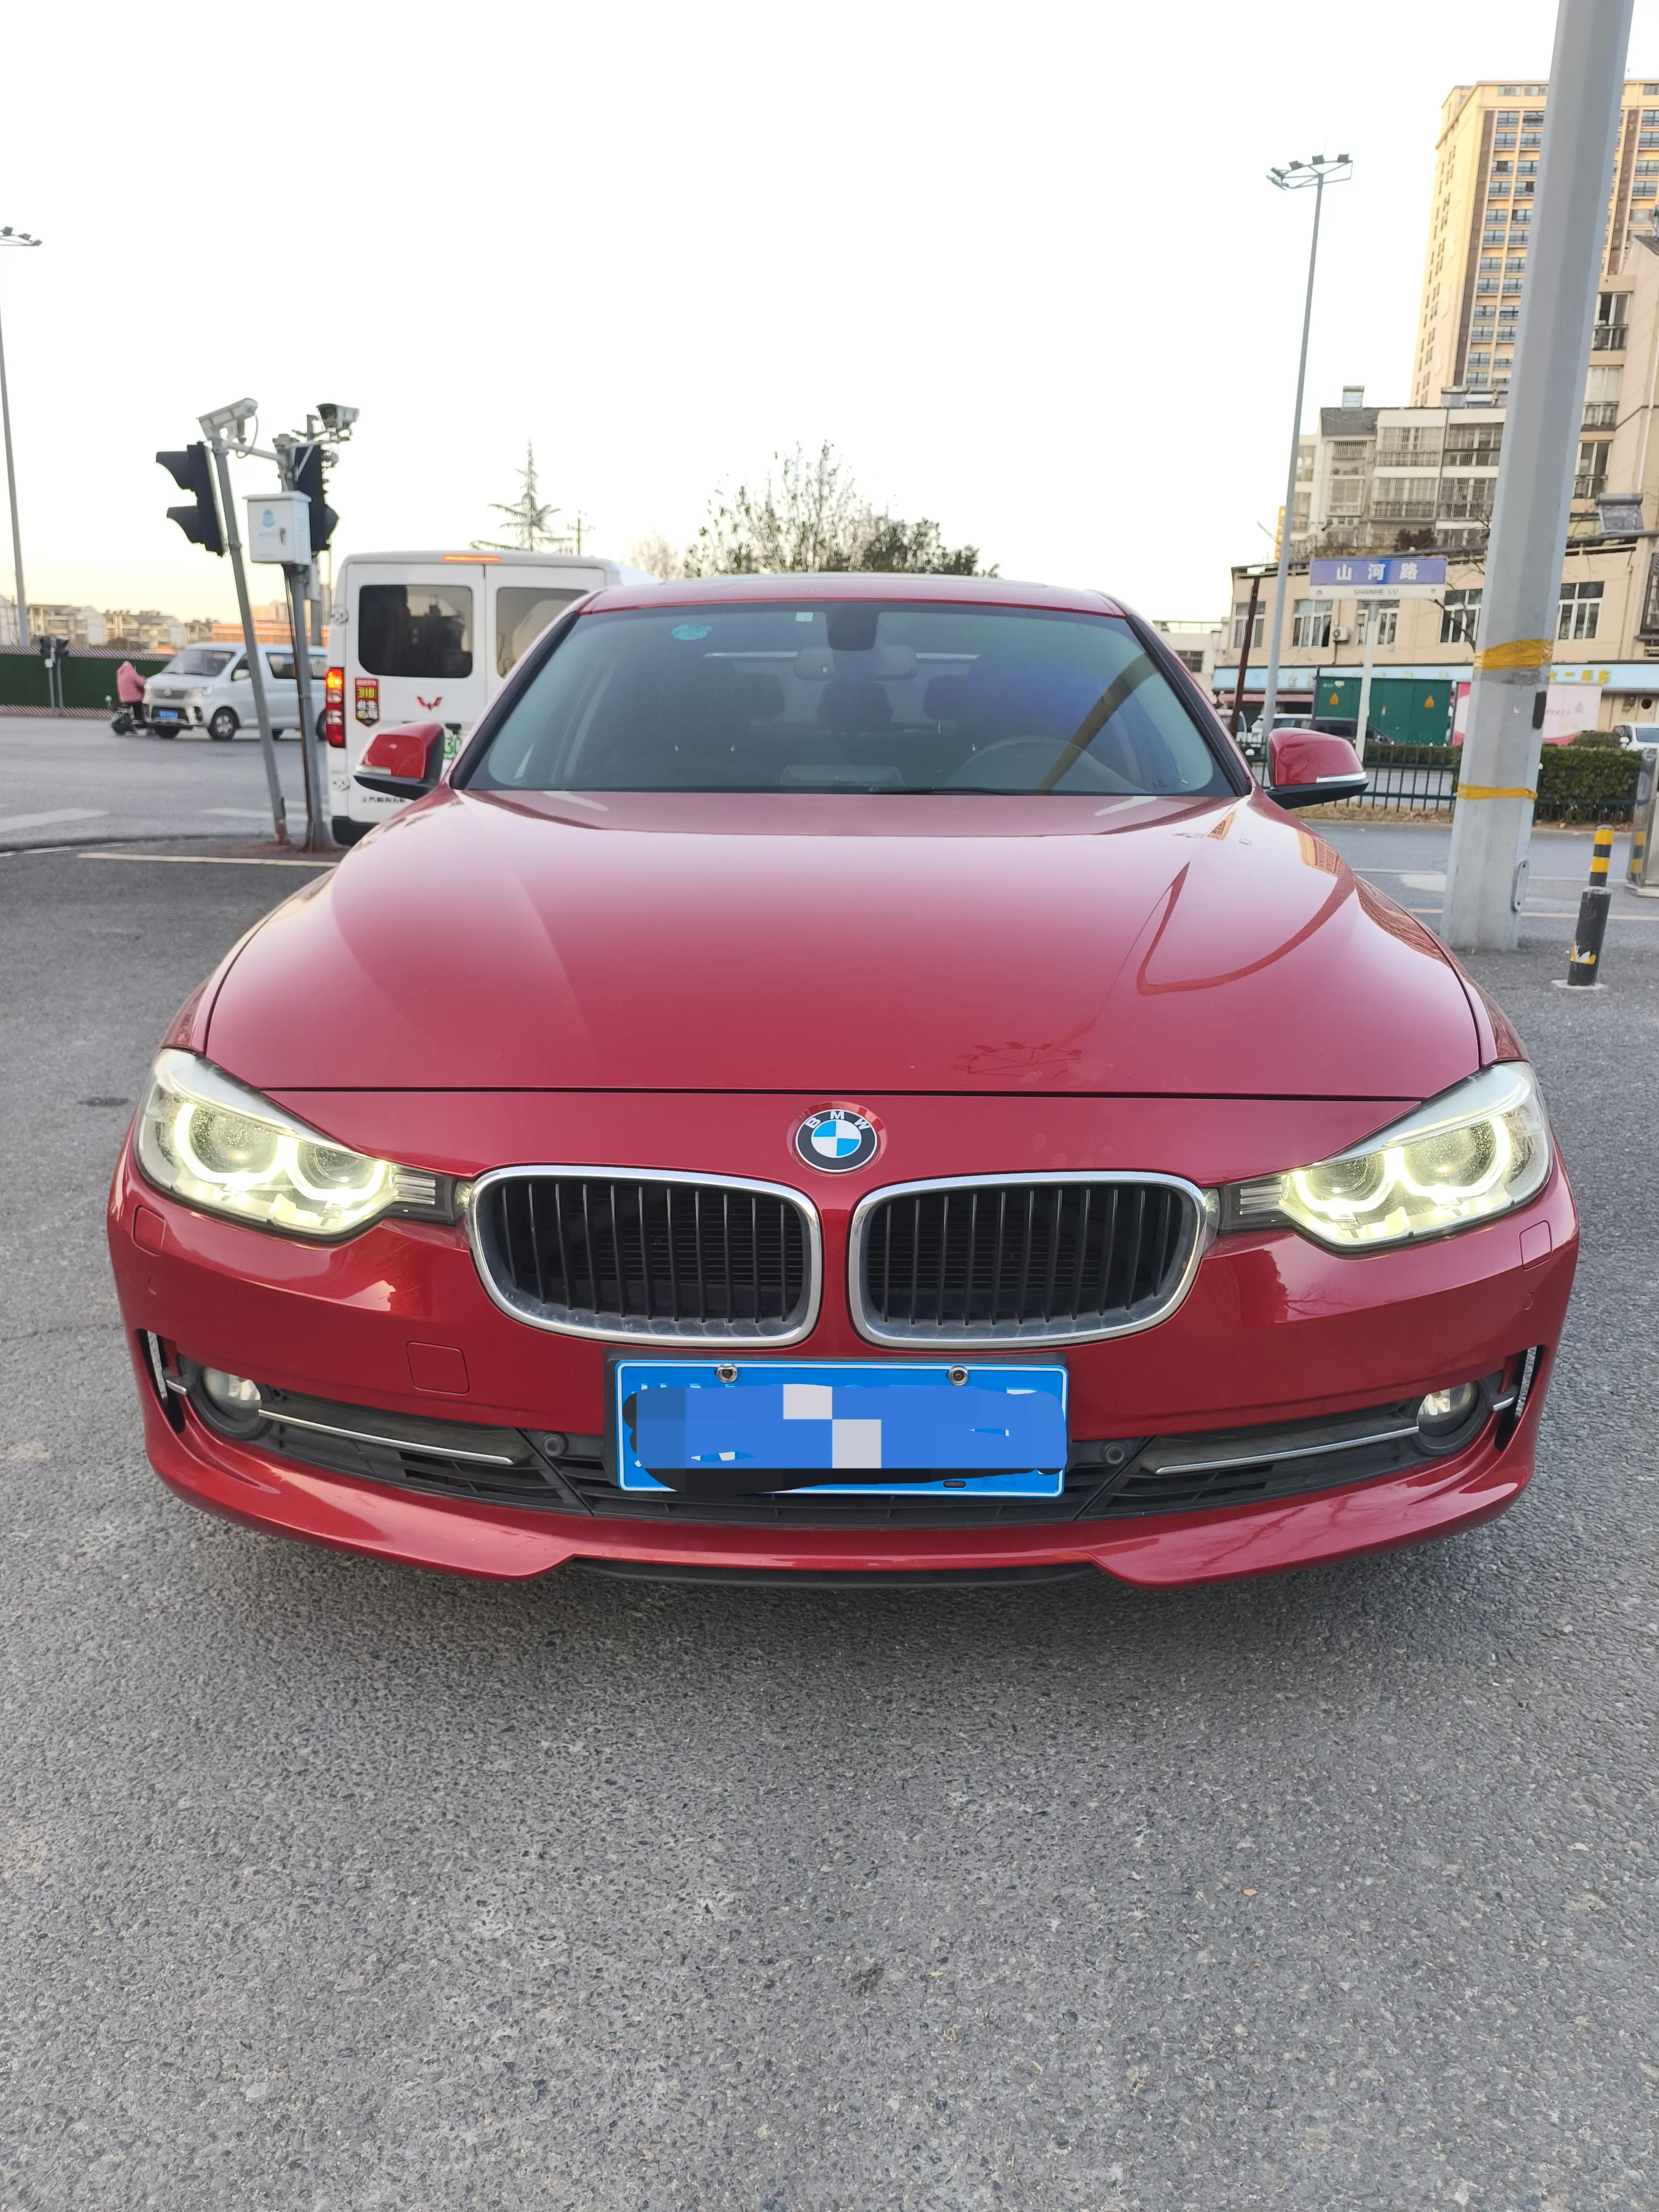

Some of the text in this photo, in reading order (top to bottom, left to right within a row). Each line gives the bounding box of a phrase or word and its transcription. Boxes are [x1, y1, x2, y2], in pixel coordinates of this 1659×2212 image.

[1336, 562, 1419, 581] 山河路
[805, 1110, 871, 1130] BMW
